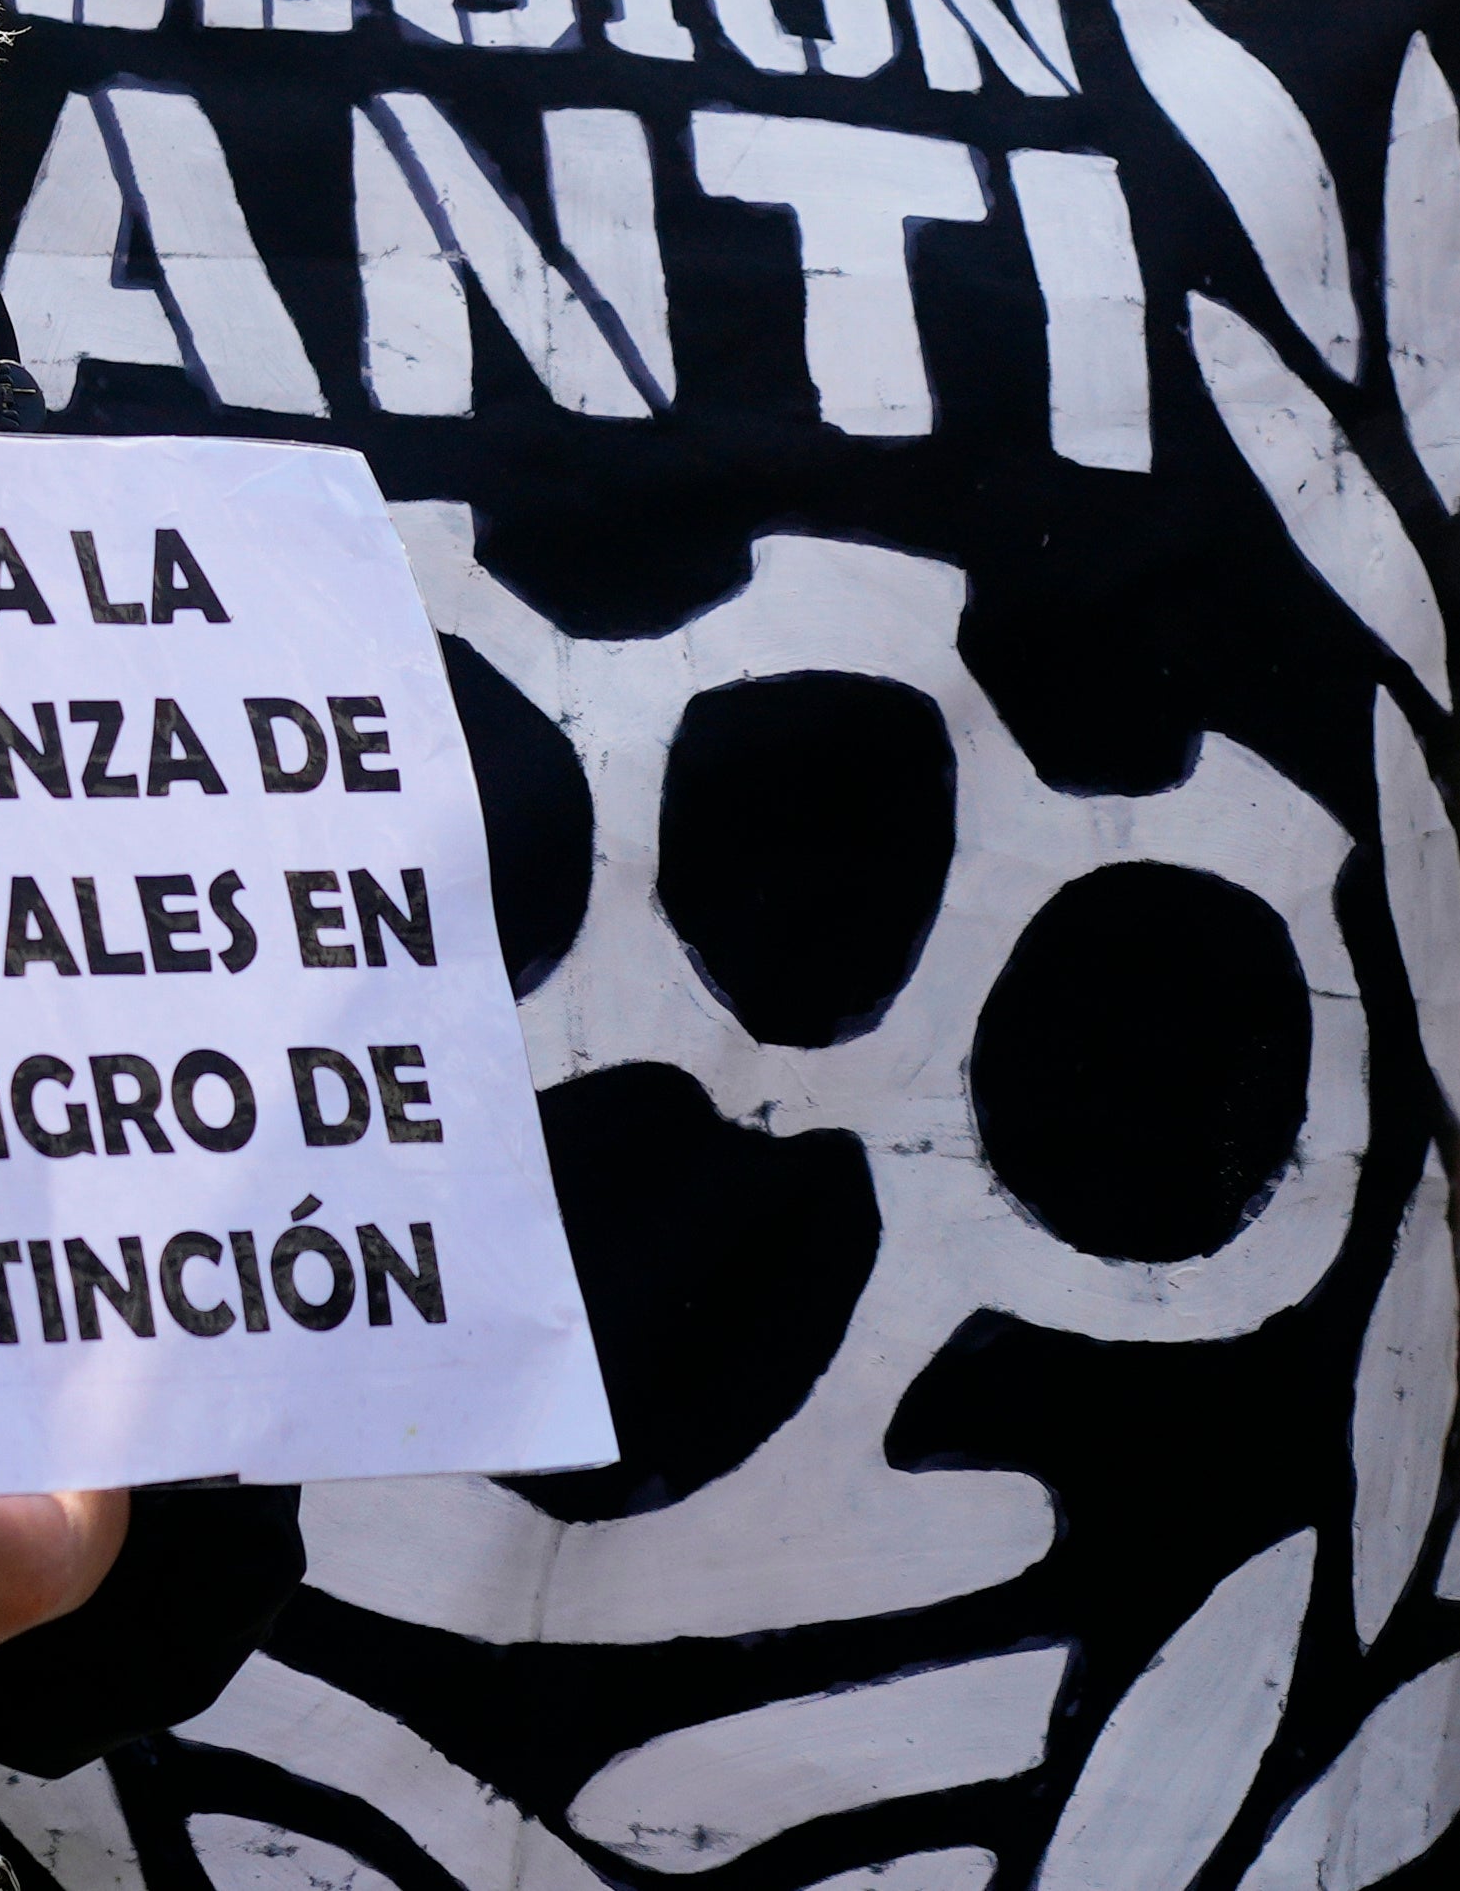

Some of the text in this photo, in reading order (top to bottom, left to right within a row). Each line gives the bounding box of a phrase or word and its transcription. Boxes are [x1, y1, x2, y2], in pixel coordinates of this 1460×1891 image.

[71, 529, 231, 625] LA
[243, 696, 401, 793] DE
[284, 868, 437, 968] EN
[287, 1045, 443, 1146] DE
